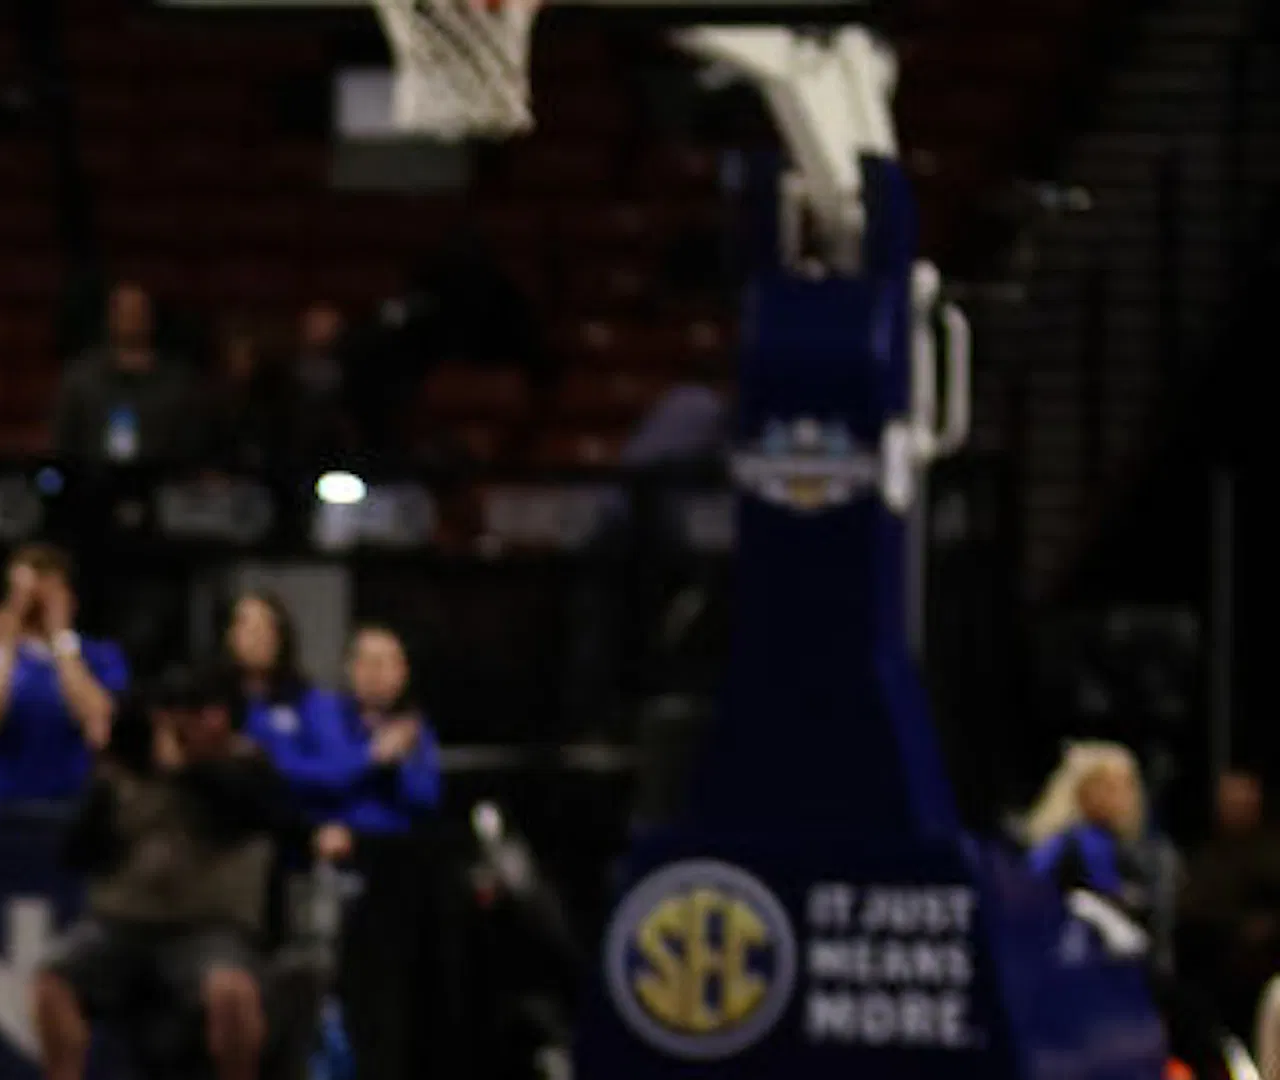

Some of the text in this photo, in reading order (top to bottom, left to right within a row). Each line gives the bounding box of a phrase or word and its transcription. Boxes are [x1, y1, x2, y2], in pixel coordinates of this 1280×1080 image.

[860, 884, 977, 935] JUST
[630, 884, 772, 1034] SEC
[807, 937, 973, 985] MEANS
